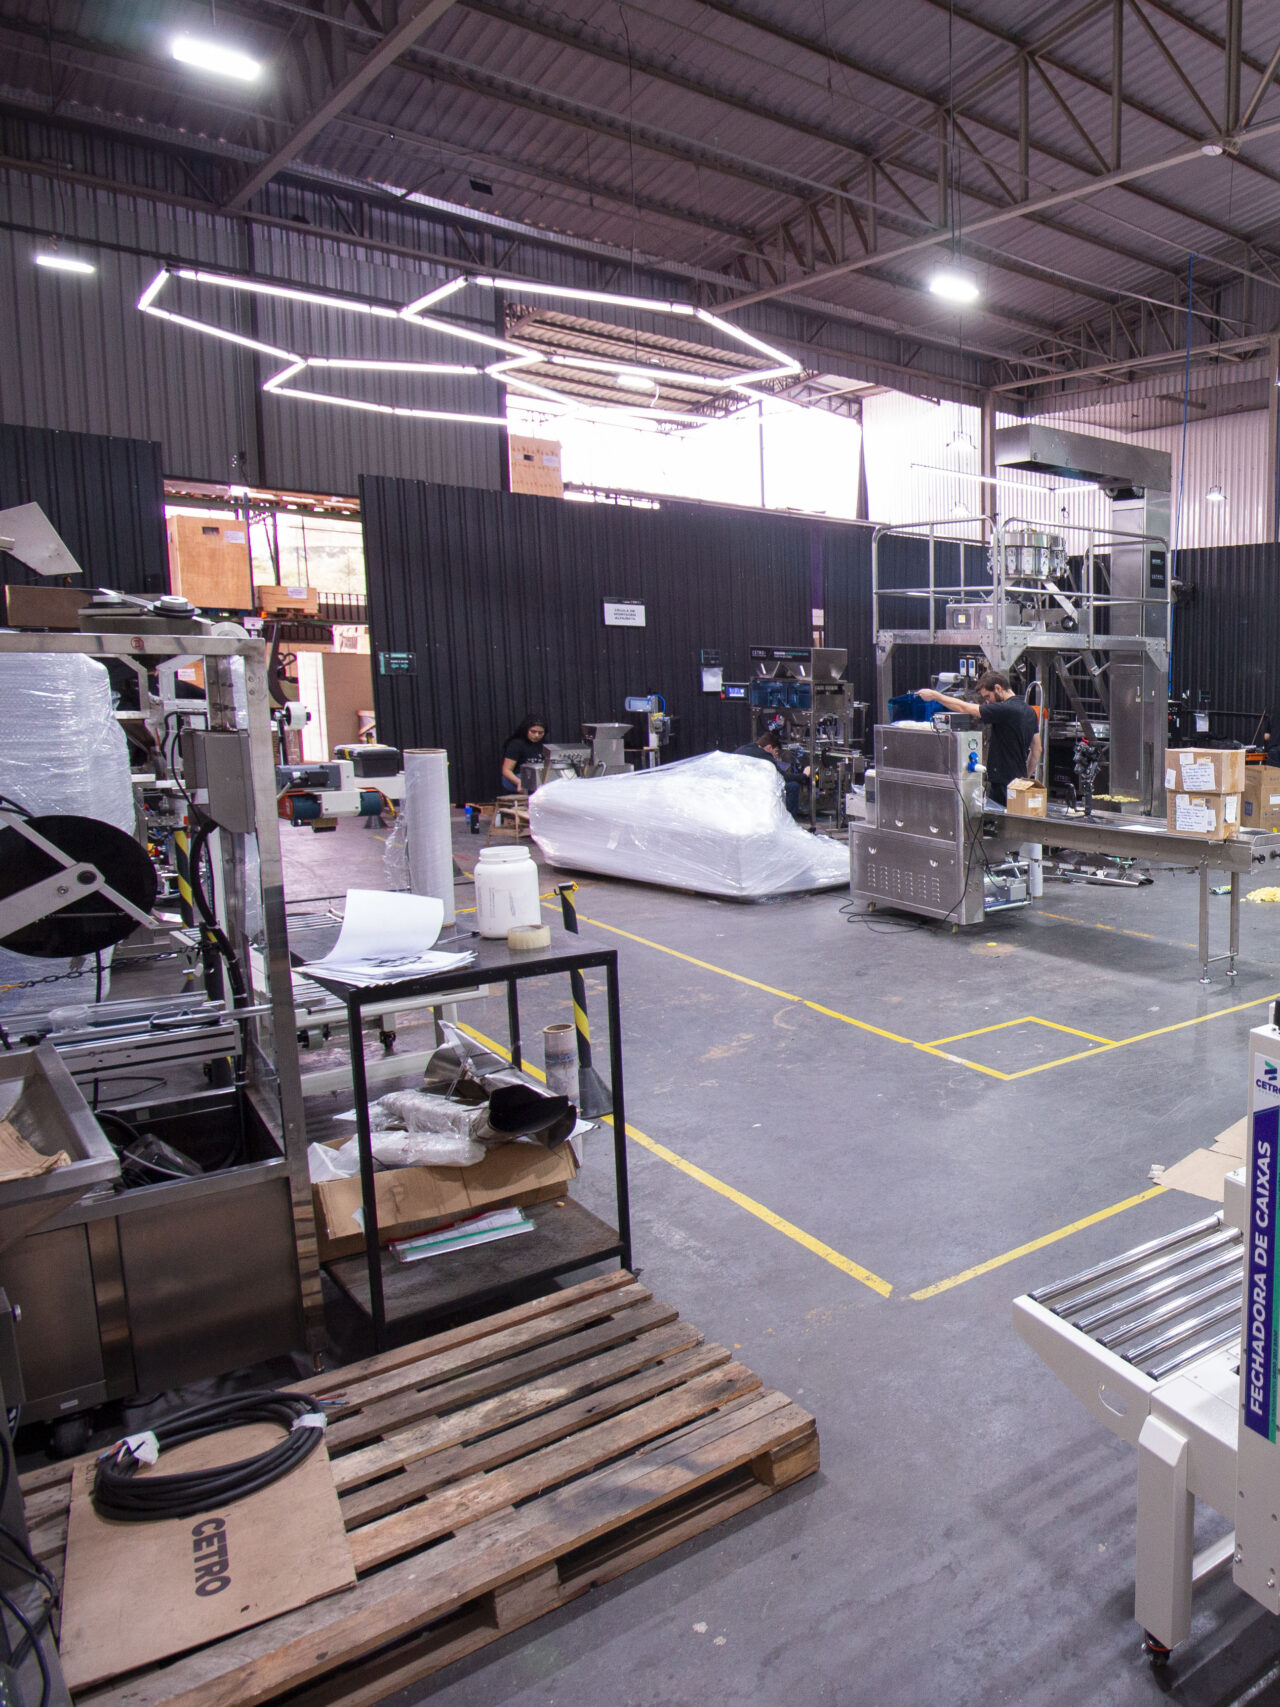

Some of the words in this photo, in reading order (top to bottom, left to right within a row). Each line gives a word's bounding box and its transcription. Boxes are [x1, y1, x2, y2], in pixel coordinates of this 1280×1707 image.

[1255, 1140, 1271, 1228] CAIXAS
[1254, 1231, 1268, 1267] DE
[1250, 1273, 1267, 1416] FECHADORA
[191, 1517, 232, 1597] CETRO
